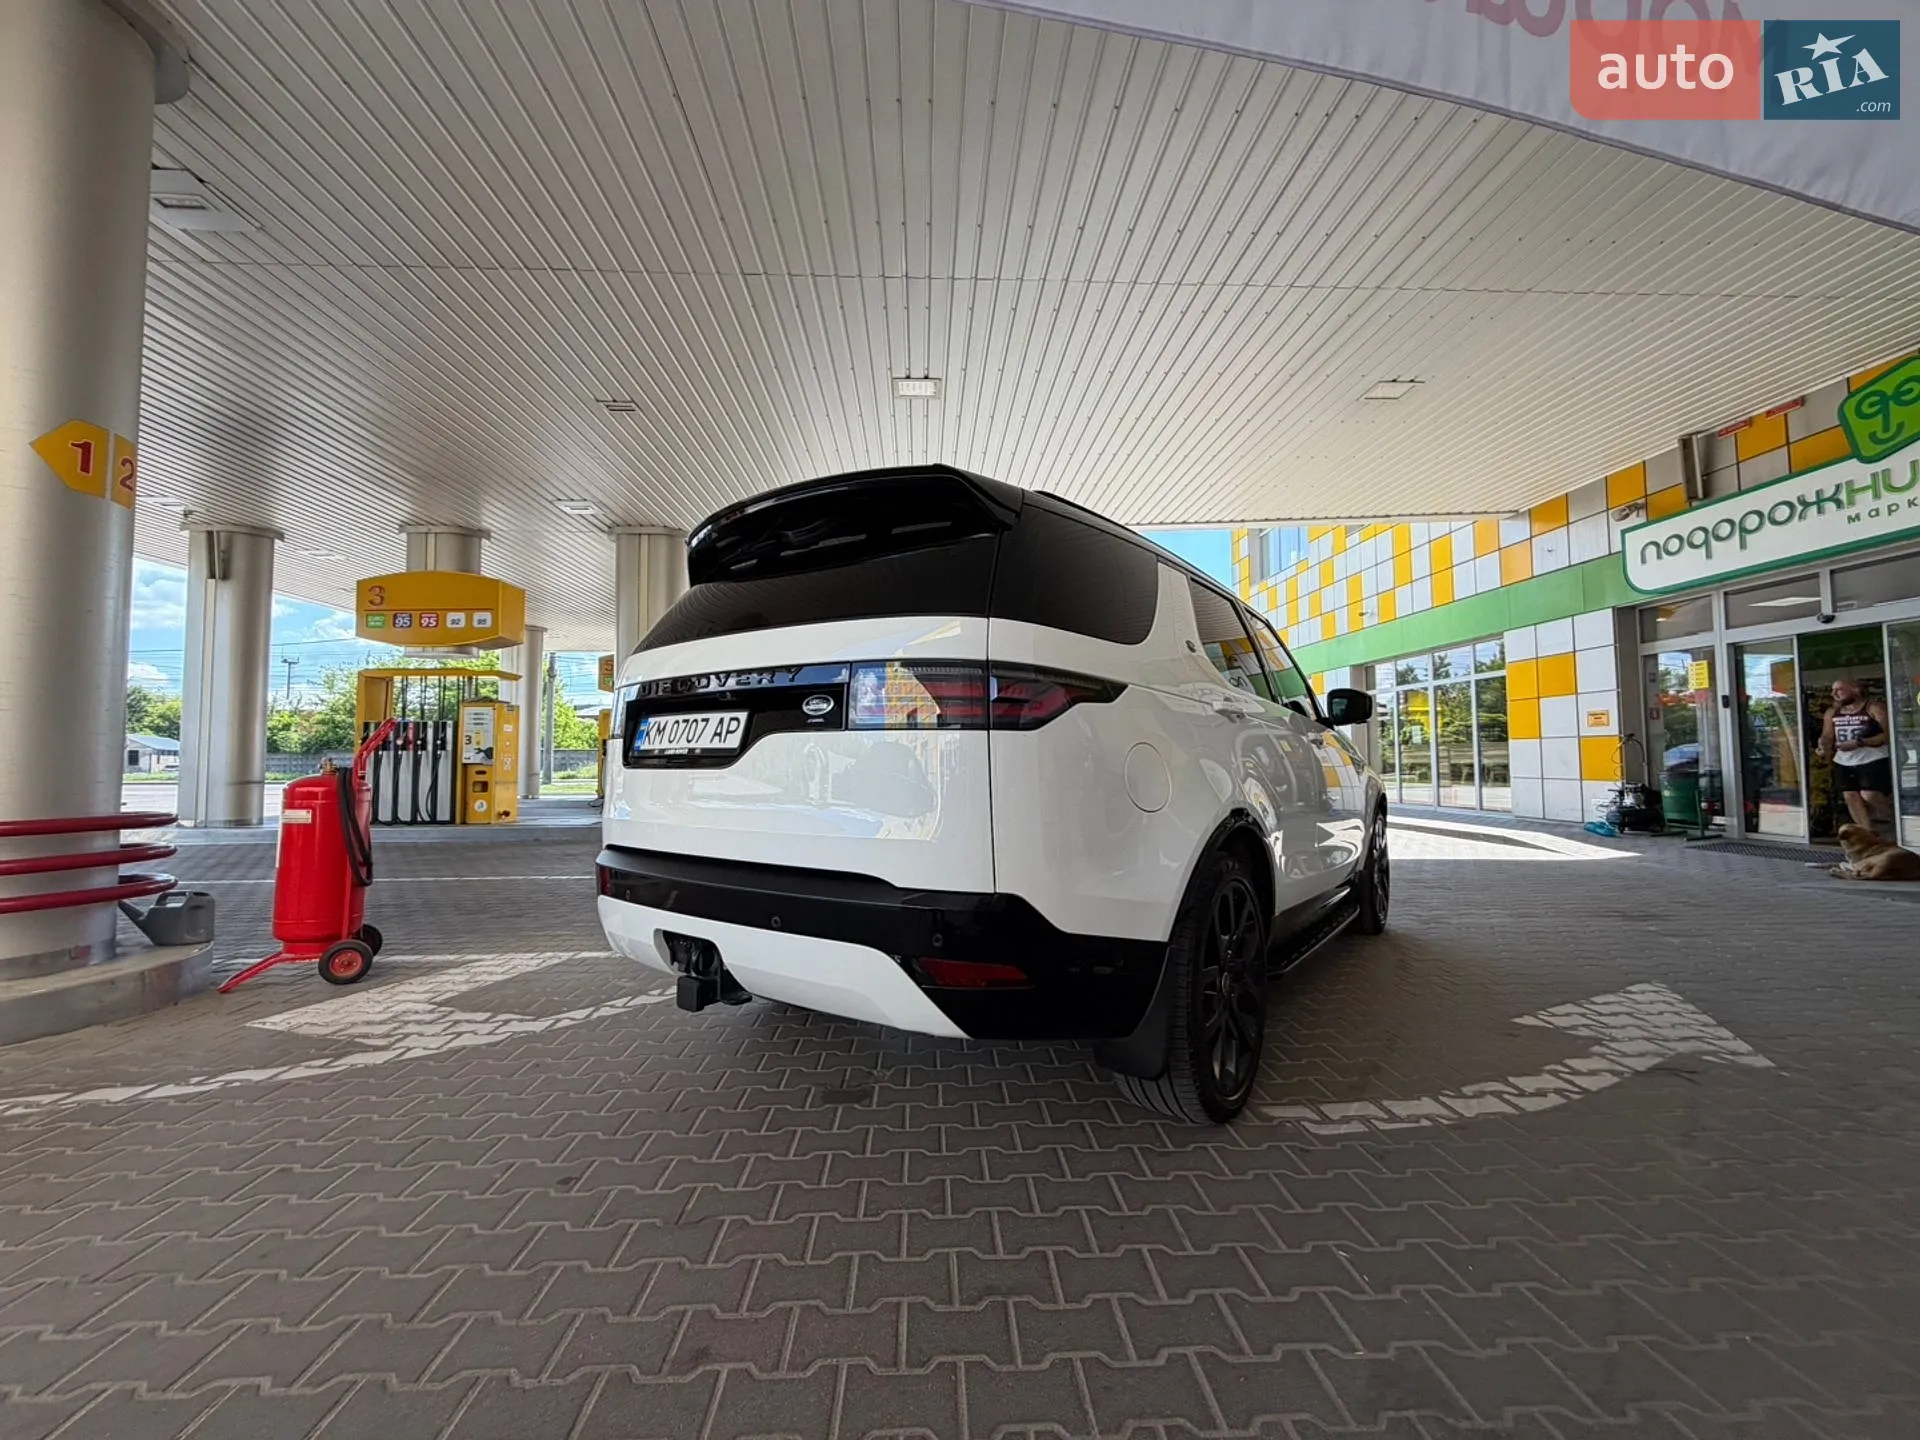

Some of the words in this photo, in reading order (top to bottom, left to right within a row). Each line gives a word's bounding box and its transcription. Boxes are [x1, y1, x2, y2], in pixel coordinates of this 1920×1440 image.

[68, 439, 94, 476] 1
[118, 455, 136, 493] 2
[368, 585, 386, 607] 3
[395, 617, 411, 628] 95
[421, 617, 437, 627] 95
[465, 735, 472, 745] 3
[644, 719, 668, 745] KM
[668, 717, 709, 745] 0707
[710, 717, 741, 744] AP
